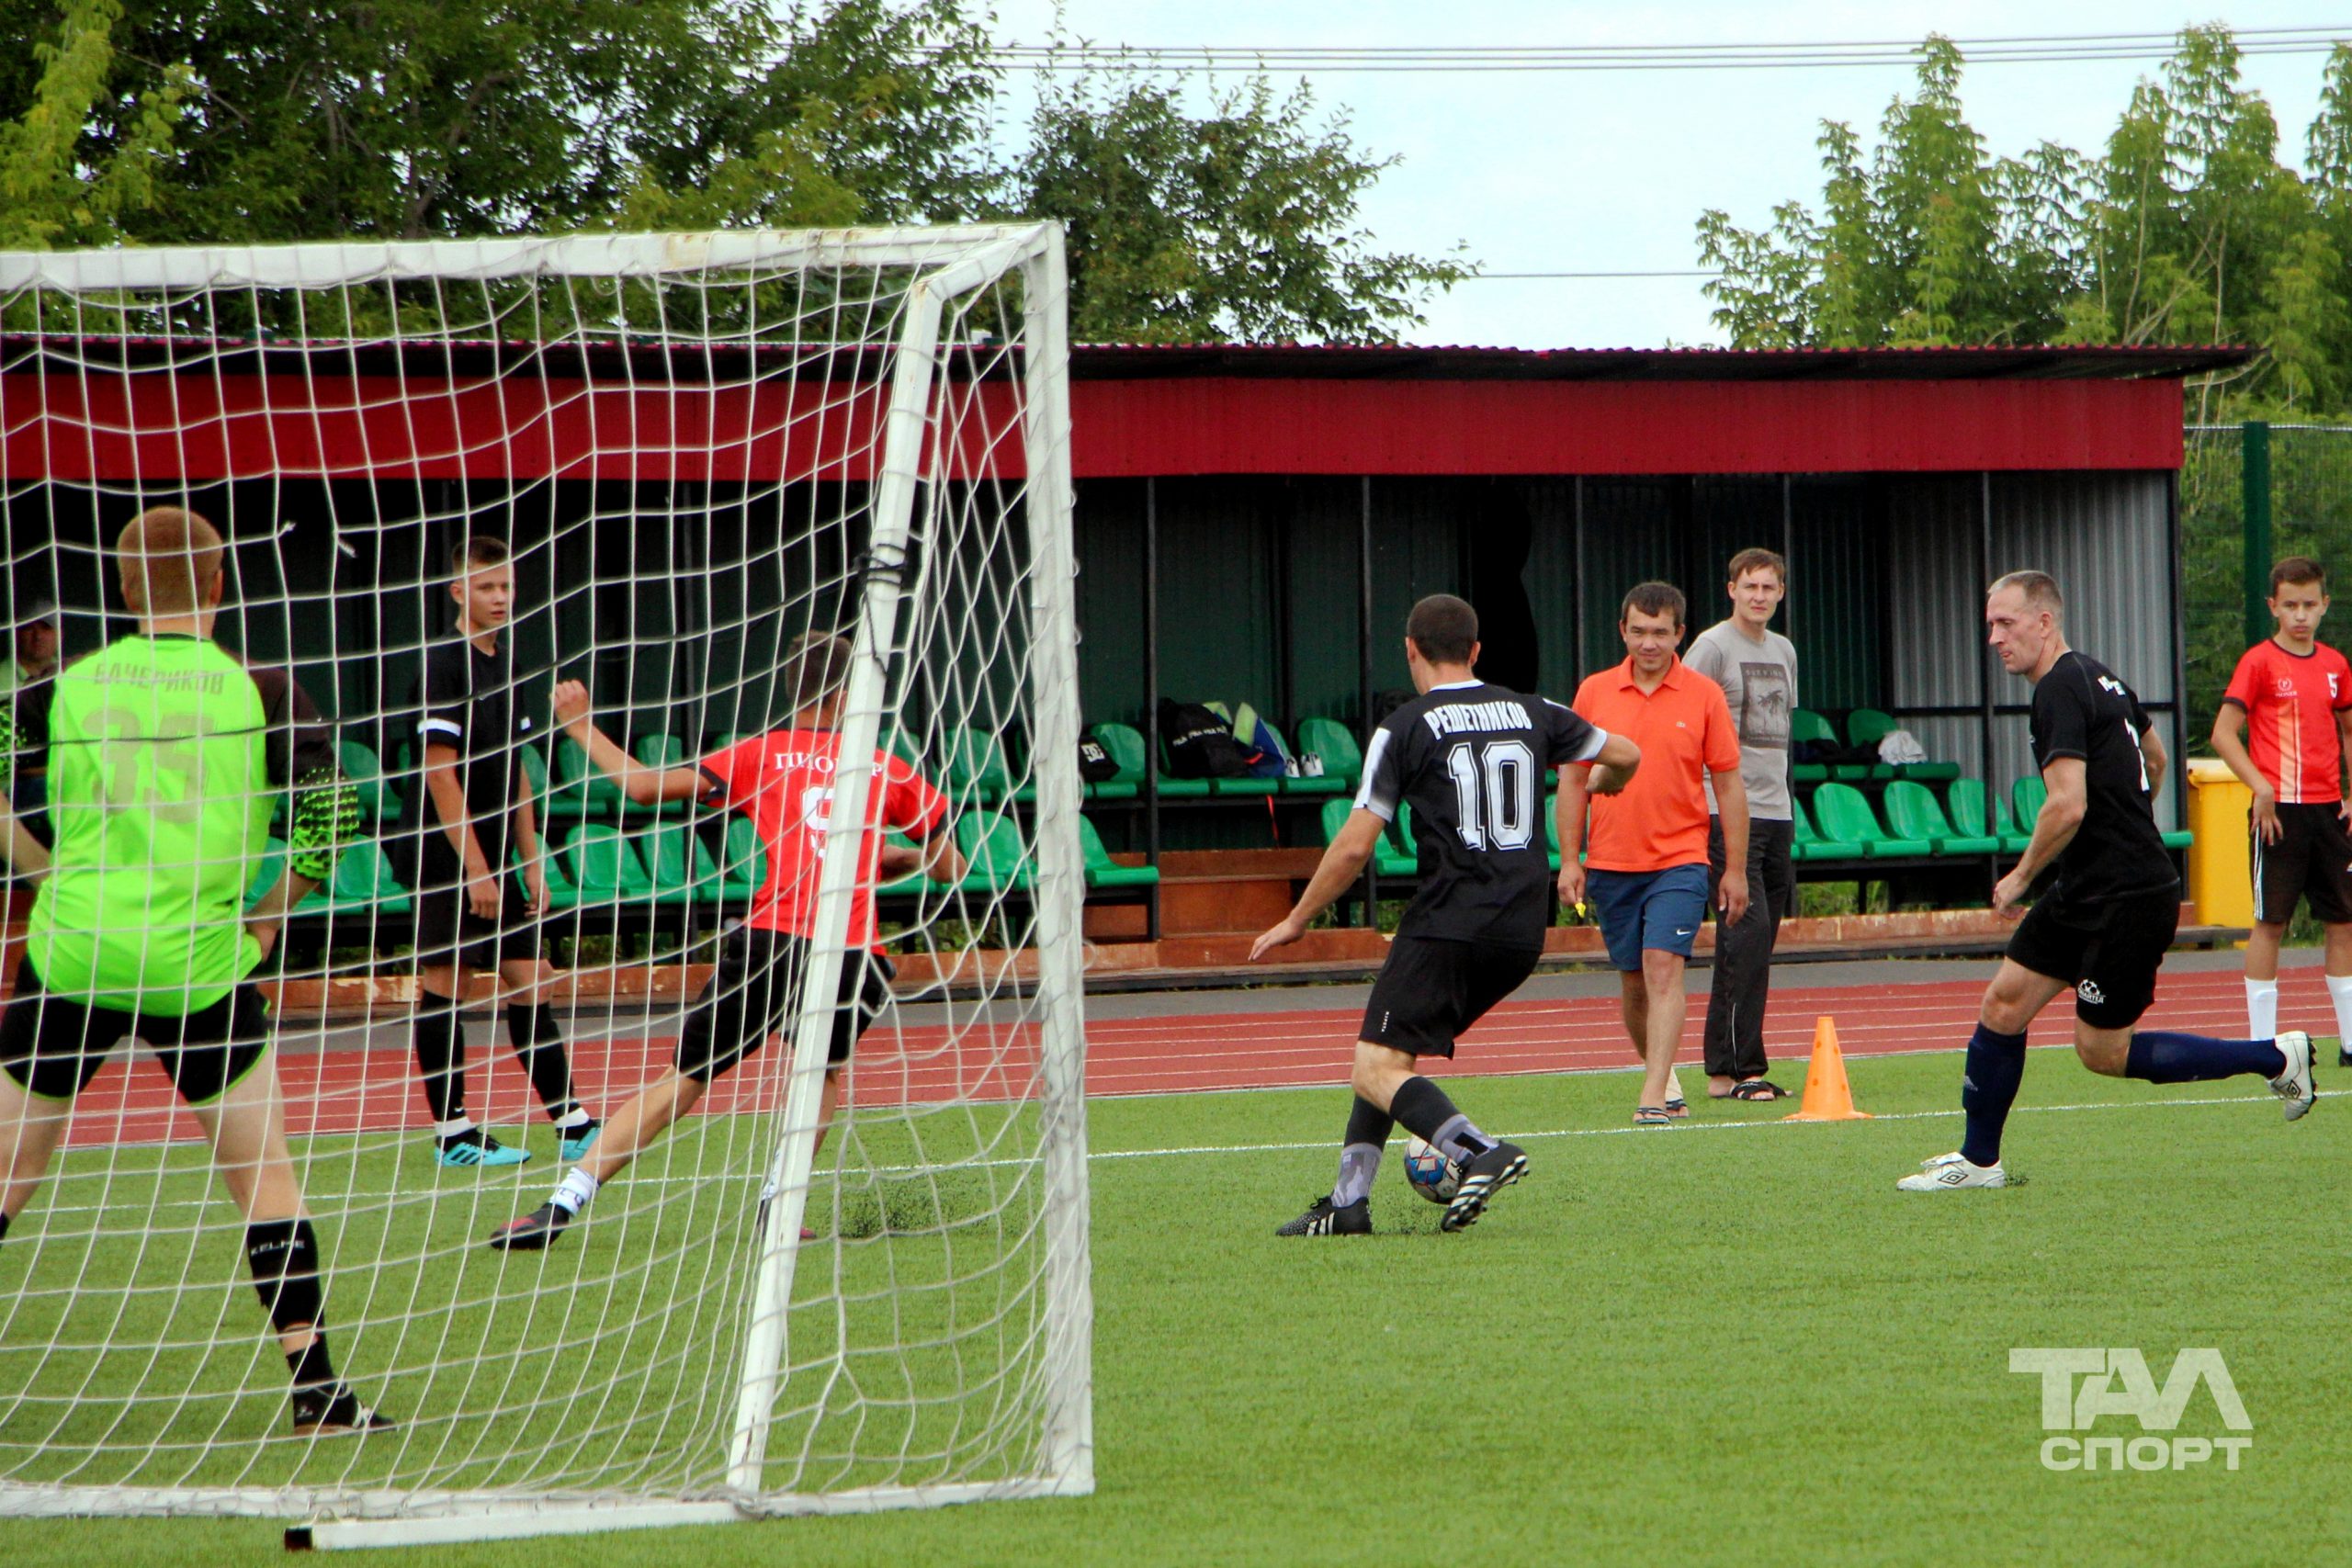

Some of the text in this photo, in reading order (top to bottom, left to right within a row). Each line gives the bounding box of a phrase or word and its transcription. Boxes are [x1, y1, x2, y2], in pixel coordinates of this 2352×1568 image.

[2326, 671, 2338, 699] 5
[1423, 701, 1533, 740] РЕШЕТНИКОВ
[82, 705, 216, 825] 35
[1448, 740, 1534, 852] 10
[250, 1238, 306, 1257] KELME
